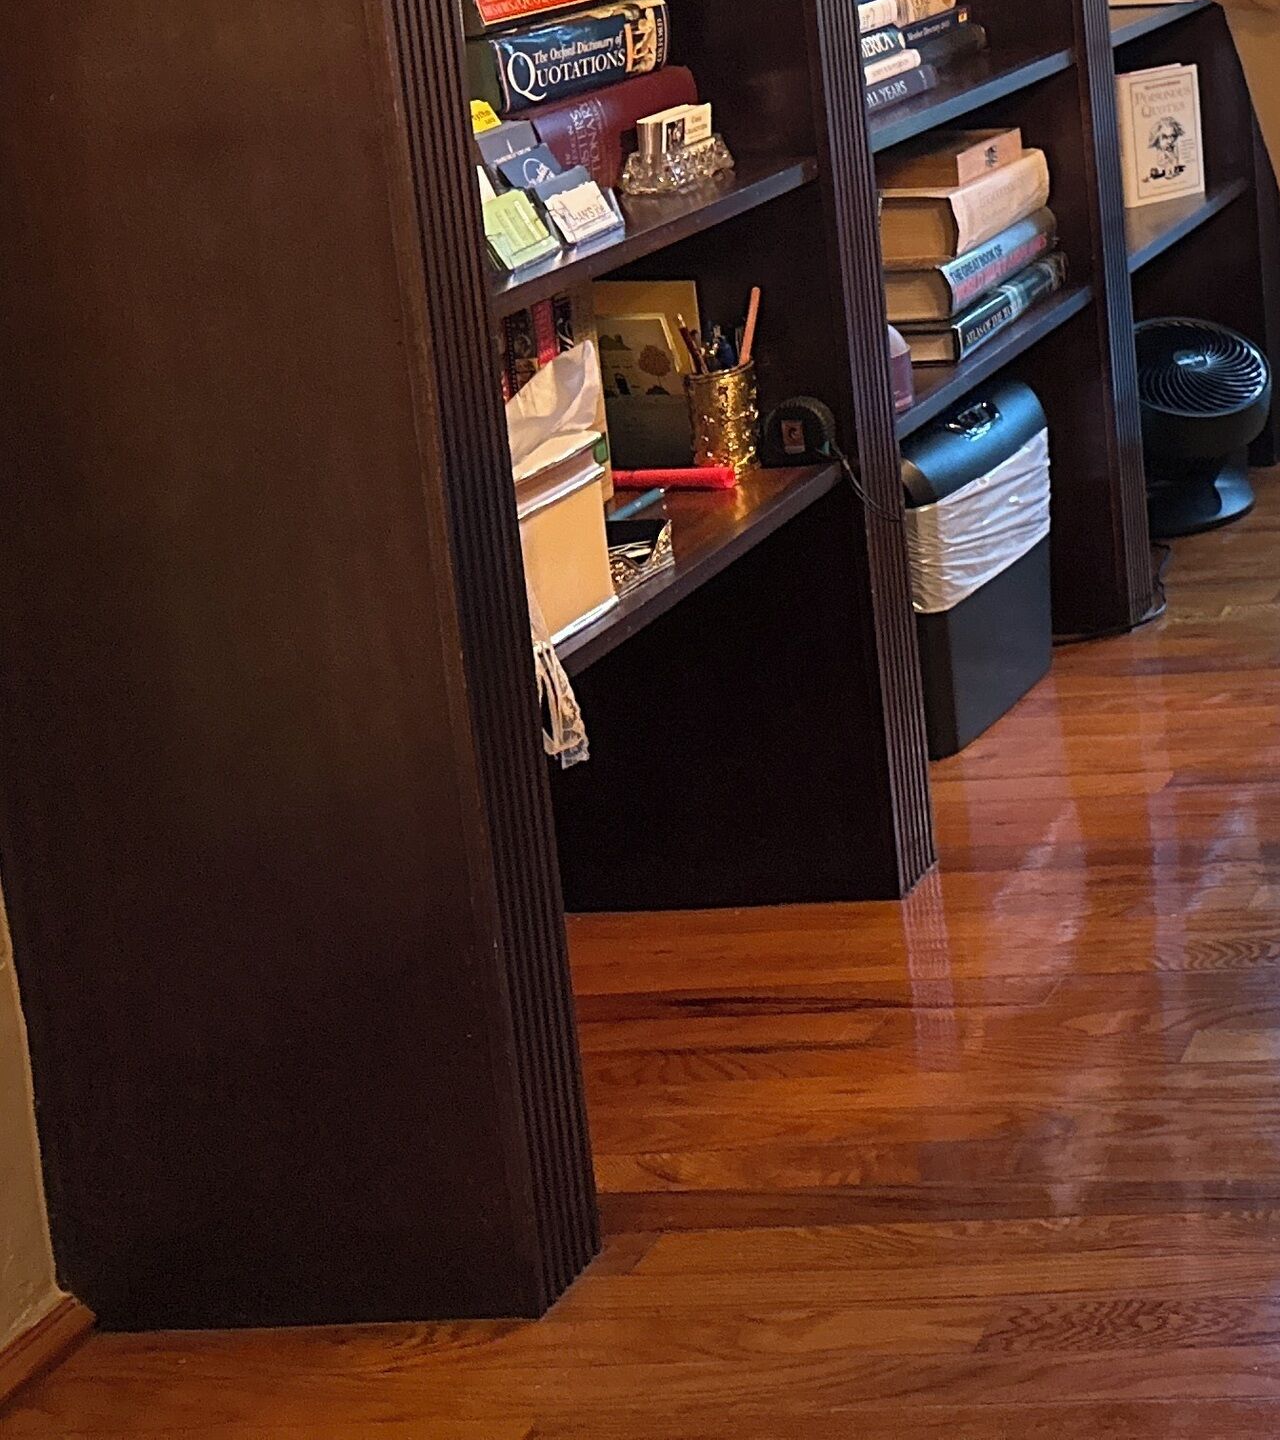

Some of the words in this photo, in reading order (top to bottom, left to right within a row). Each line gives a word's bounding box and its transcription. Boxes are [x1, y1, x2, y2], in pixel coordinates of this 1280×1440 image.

[533, 49, 549, 65] The
[550, 44, 576, 62] Oxford
[577, 35, 614, 56] Dictionary
[614, 30, 624, 49] of
[507, 48, 626, 101] QUOTATIONS
[879, 79, 908, 103] YEARS
[950, 266, 964, 285] THE
[962, 256, 982, 279] GREAT
[979, 250, 998, 271] BOOK
